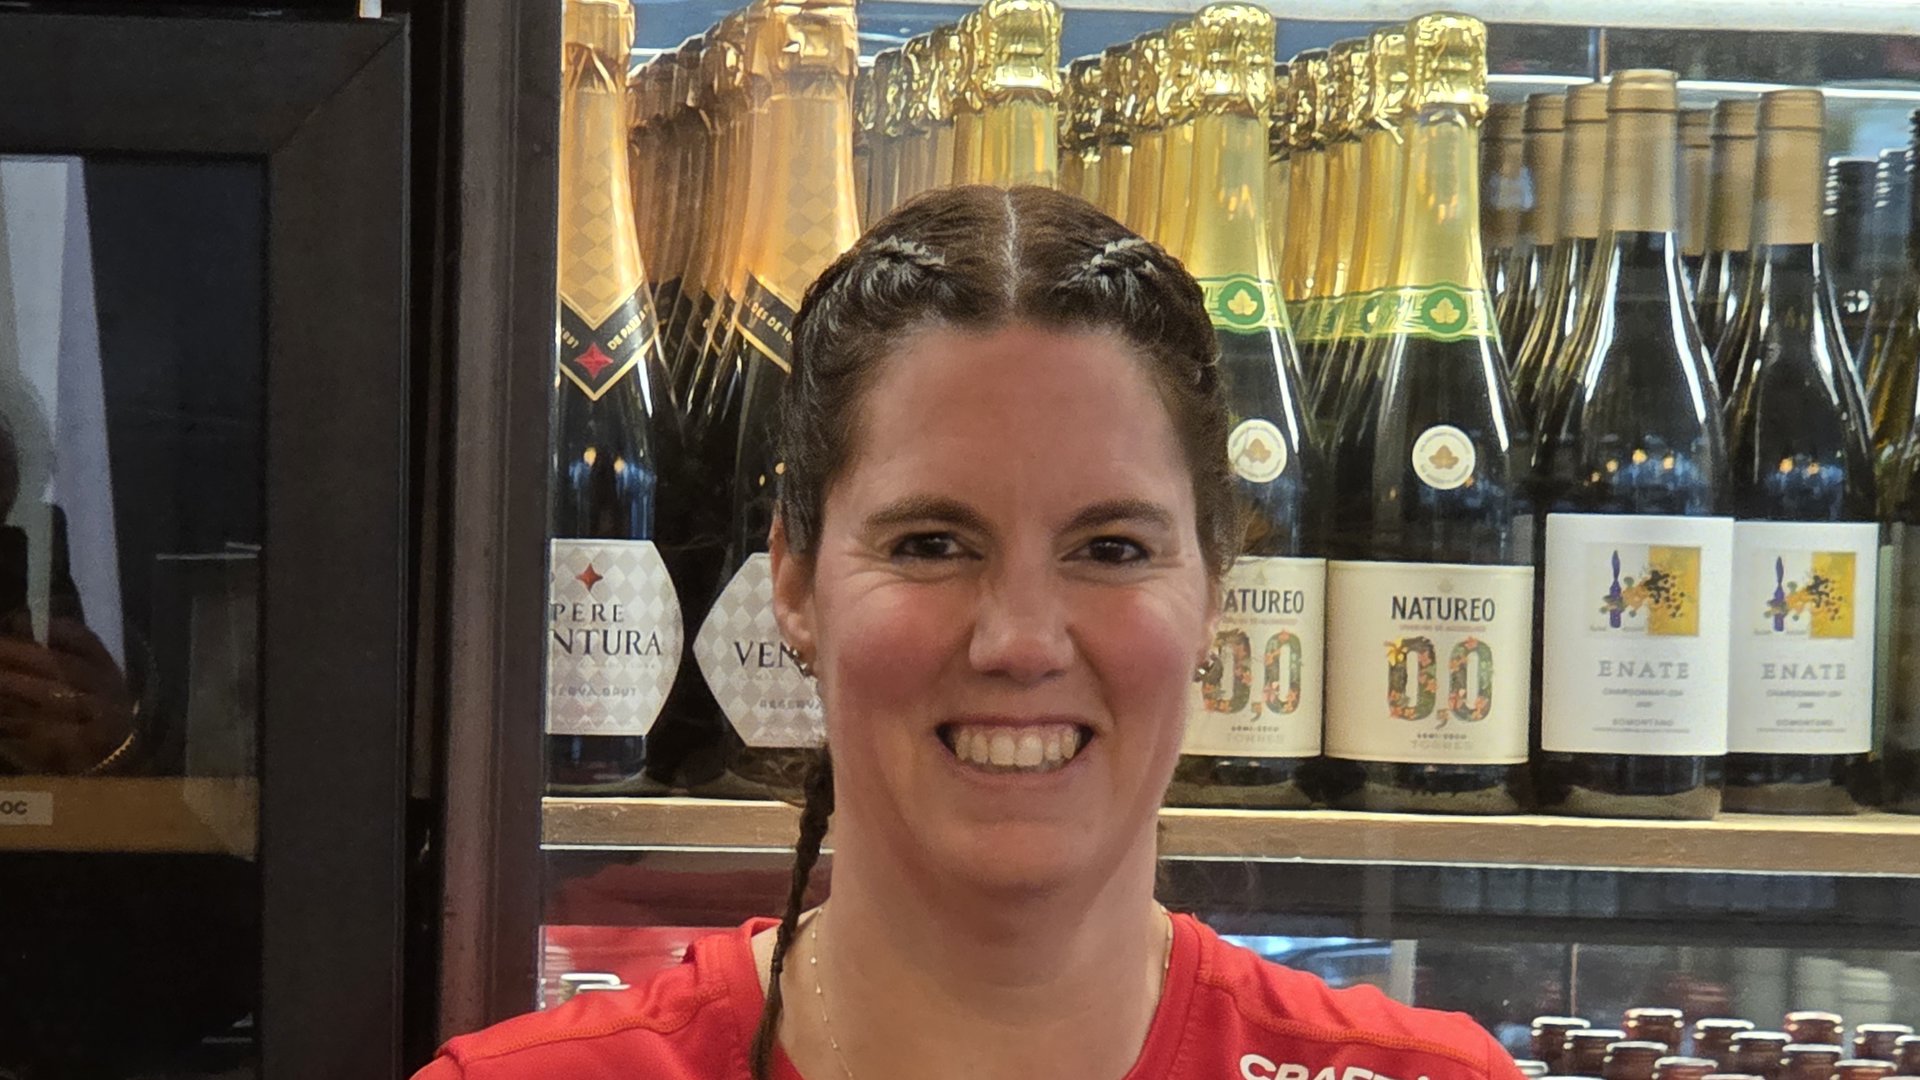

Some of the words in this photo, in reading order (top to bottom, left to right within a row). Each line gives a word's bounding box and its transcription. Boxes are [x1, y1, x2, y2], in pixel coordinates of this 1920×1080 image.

[550, 603, 624, 622] PERE
[1391, 596, 1496, 622] NATUREO
[1597, 660, 1690, 679] ENATE
[1761, 663, 1846, 680] ENATE
